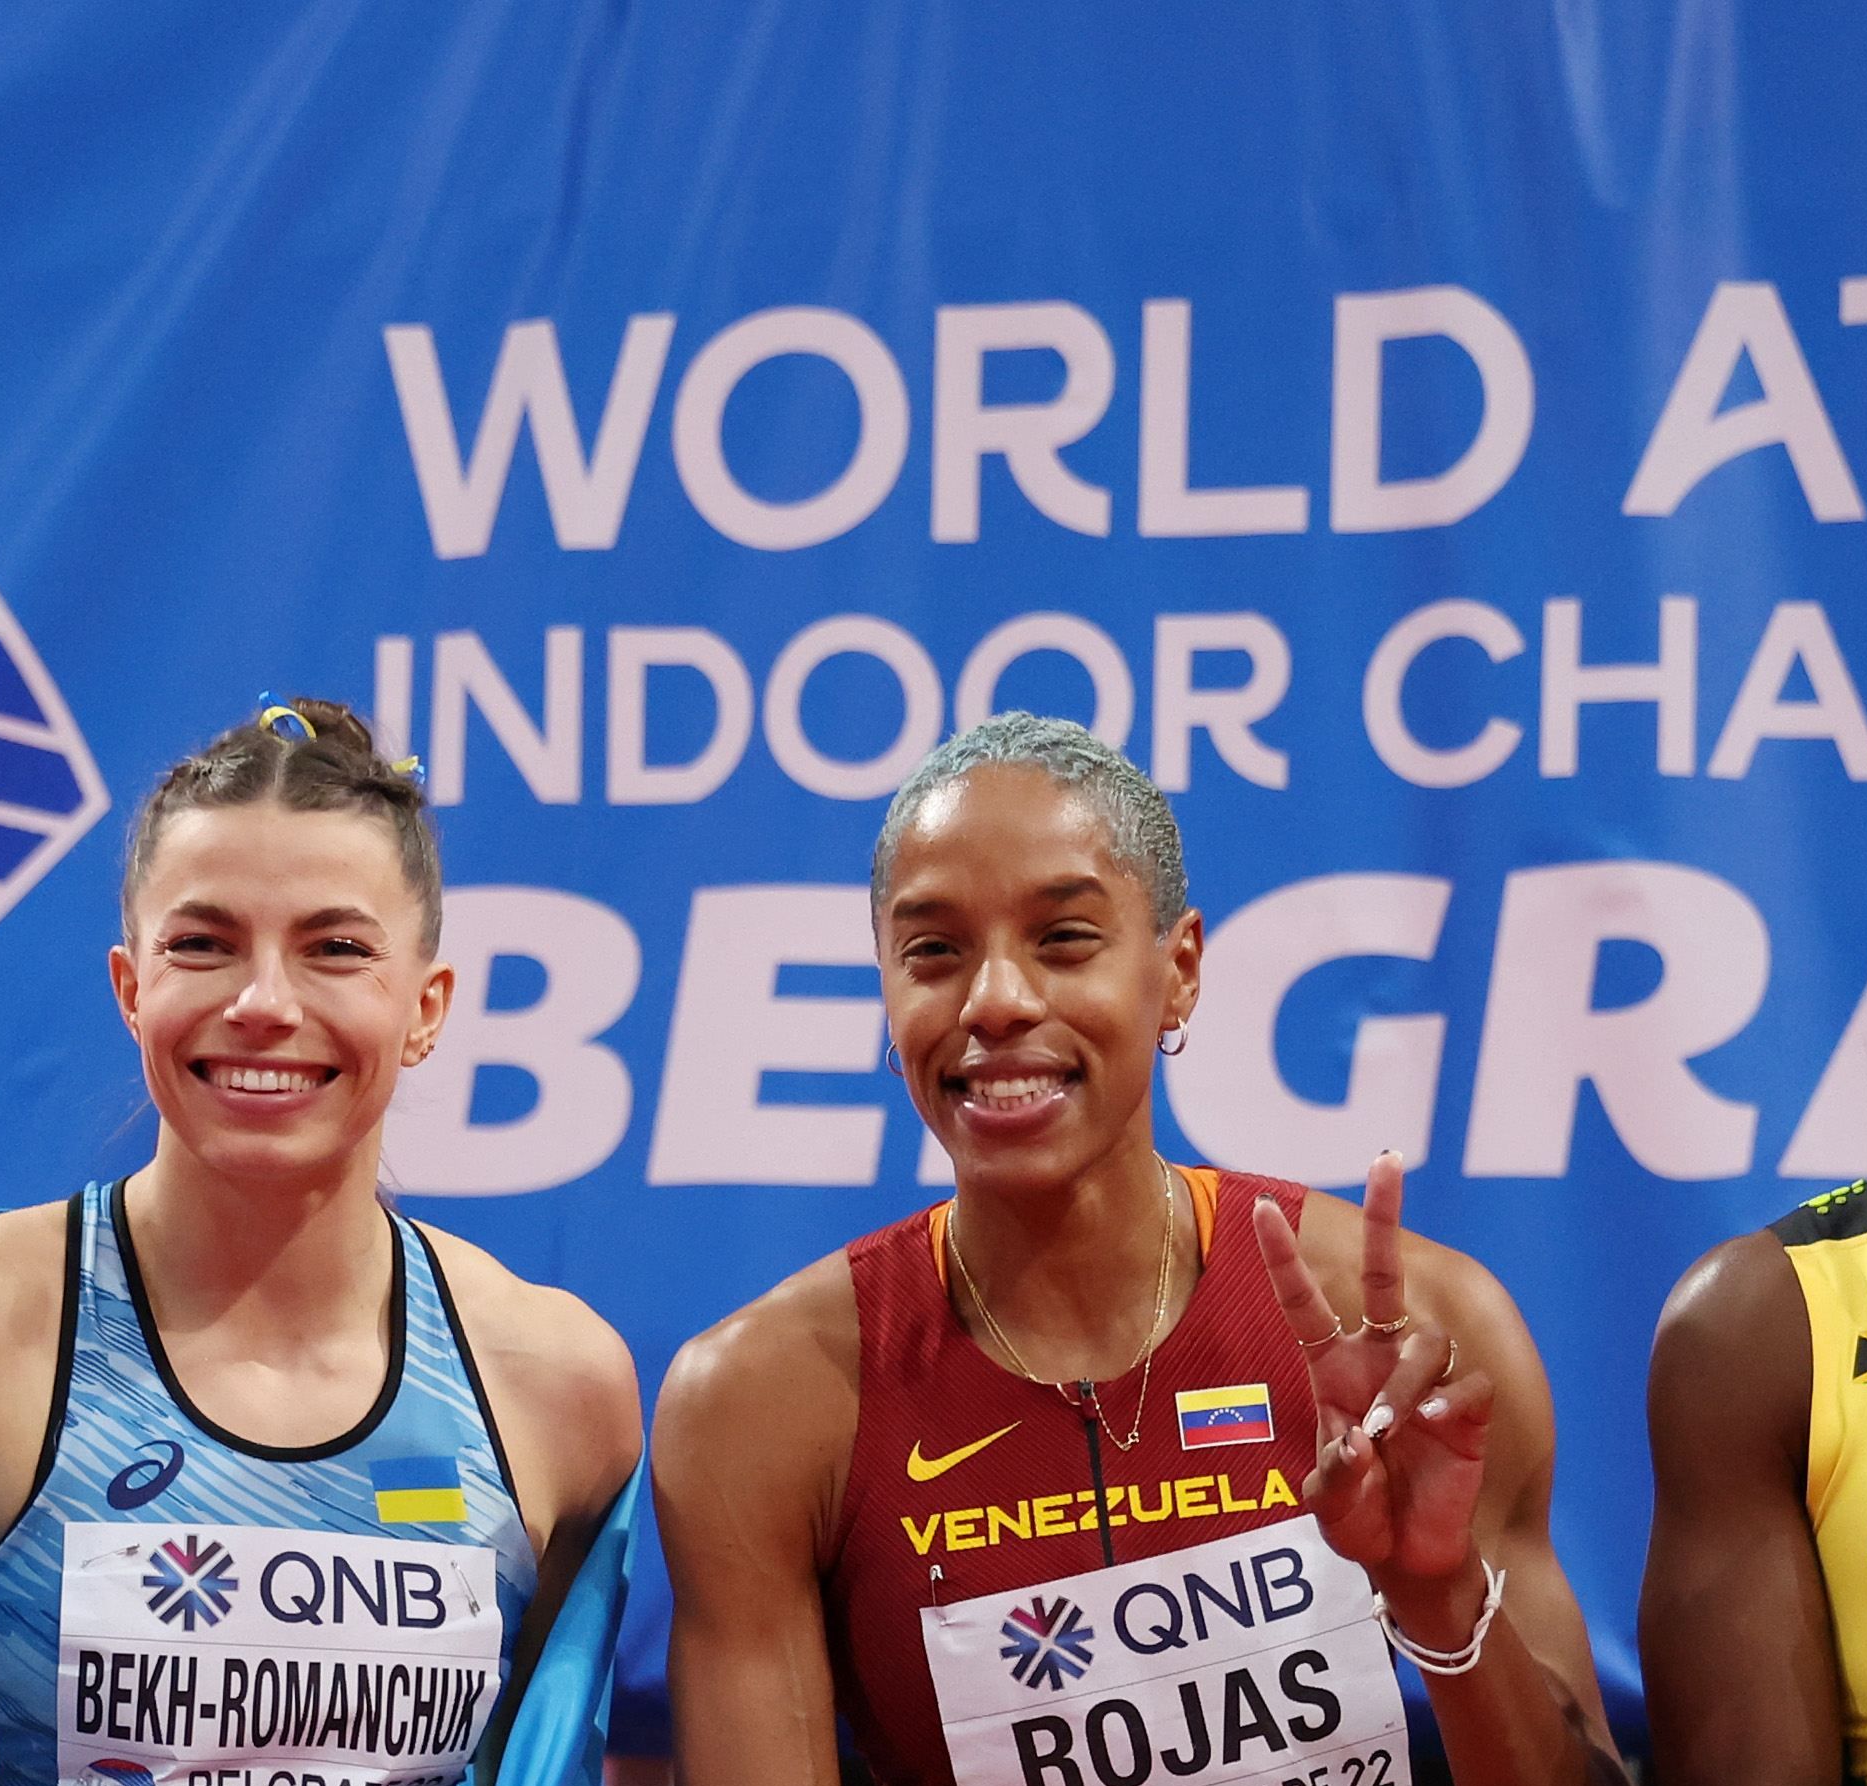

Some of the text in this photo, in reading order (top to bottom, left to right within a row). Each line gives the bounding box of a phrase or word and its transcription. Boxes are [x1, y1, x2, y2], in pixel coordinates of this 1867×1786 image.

[384, 286, 1535, 560] WORLD
[372, 610, 1292, 806] INDOOR
[900, 1468, 1299, 1556] VENEZUELA
[259, 1550, 447, 1630] QNB
[1112, 1546, 1315, 1656] QNB
[75, 1650, 486, 1757] BEKH-ROMANCHUK
